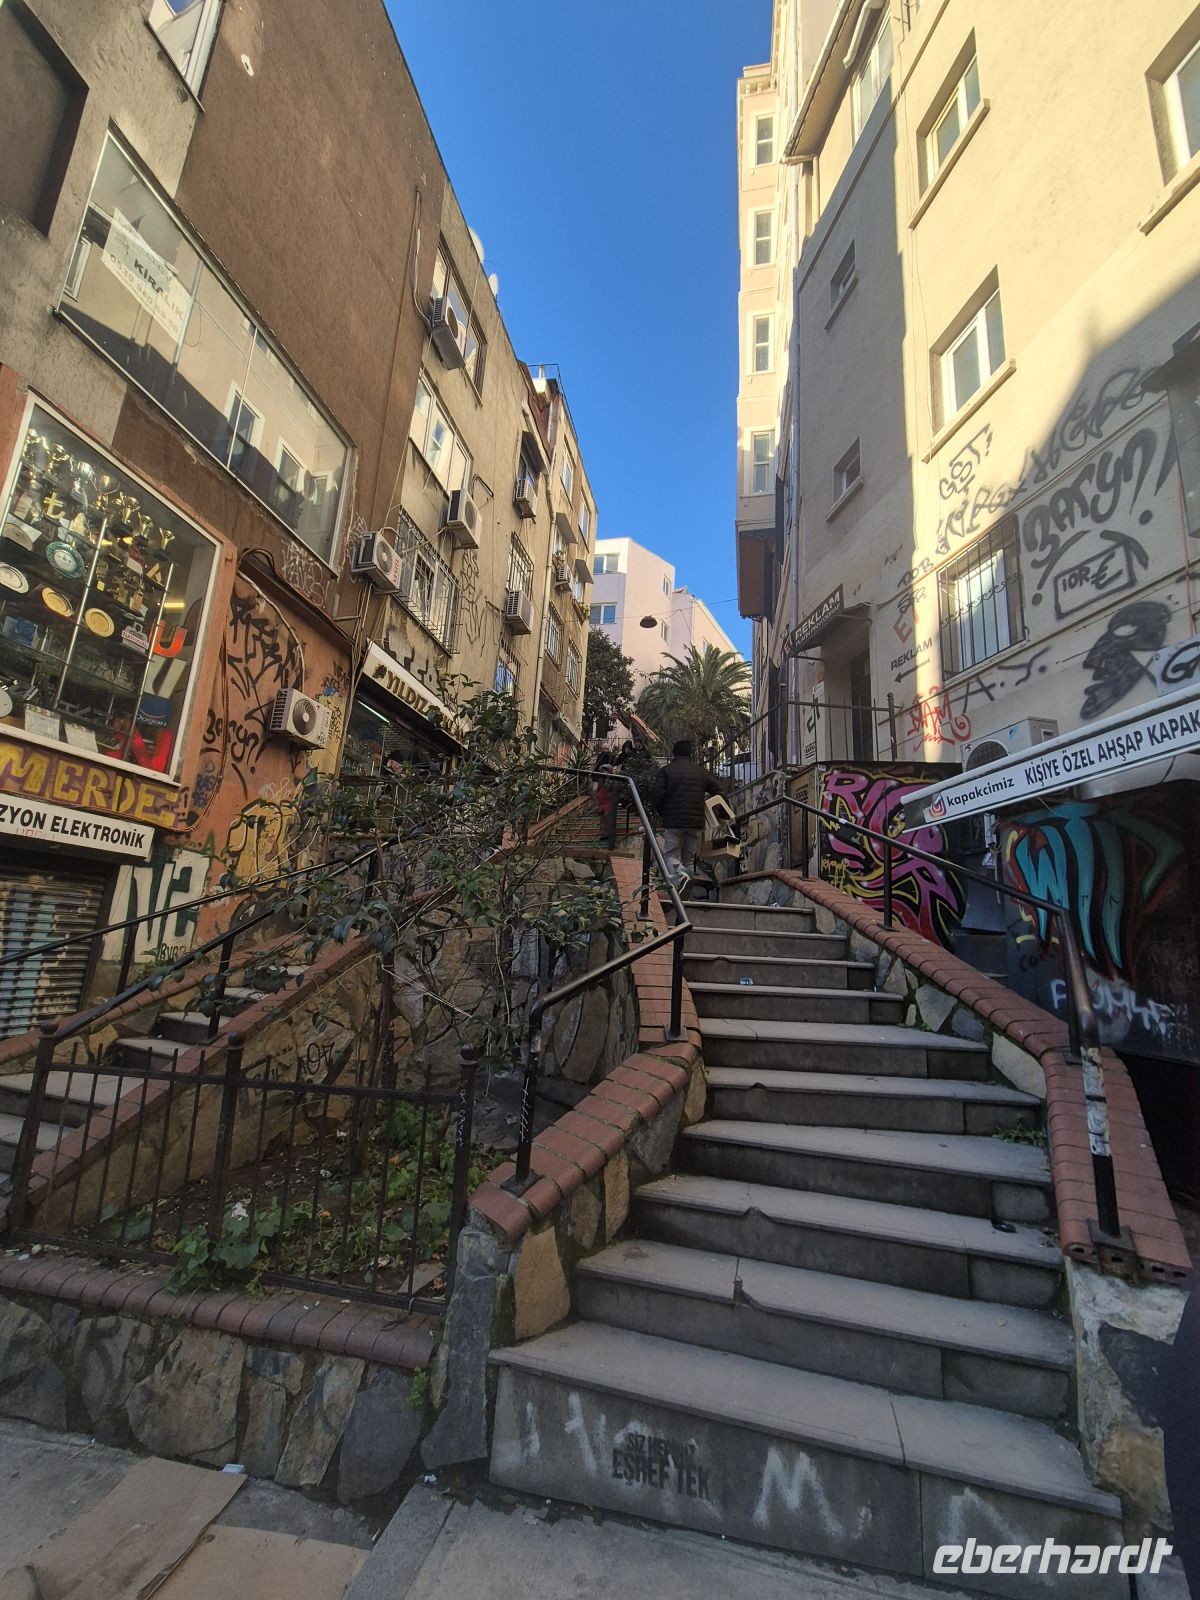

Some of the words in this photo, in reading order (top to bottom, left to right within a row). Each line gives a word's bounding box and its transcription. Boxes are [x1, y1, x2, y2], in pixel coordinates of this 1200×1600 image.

[795, 590, 840, 641] REKLAM
[891, 637, 933, 671] REKLAM
[946, 776, 1016, 808] kapakcimiz
[1024, 756, 1062, 788] KİŞİYE
[1062, 750, 1096, 774] ÖZEL
[1098, 730, 1144, 762] AHŞAP
[1147, 709, 1200, 746] KAPAK
[50, 815, 146, 849] ELEKTRONİK
[612, 1448, 669, 1488] EŞREF
